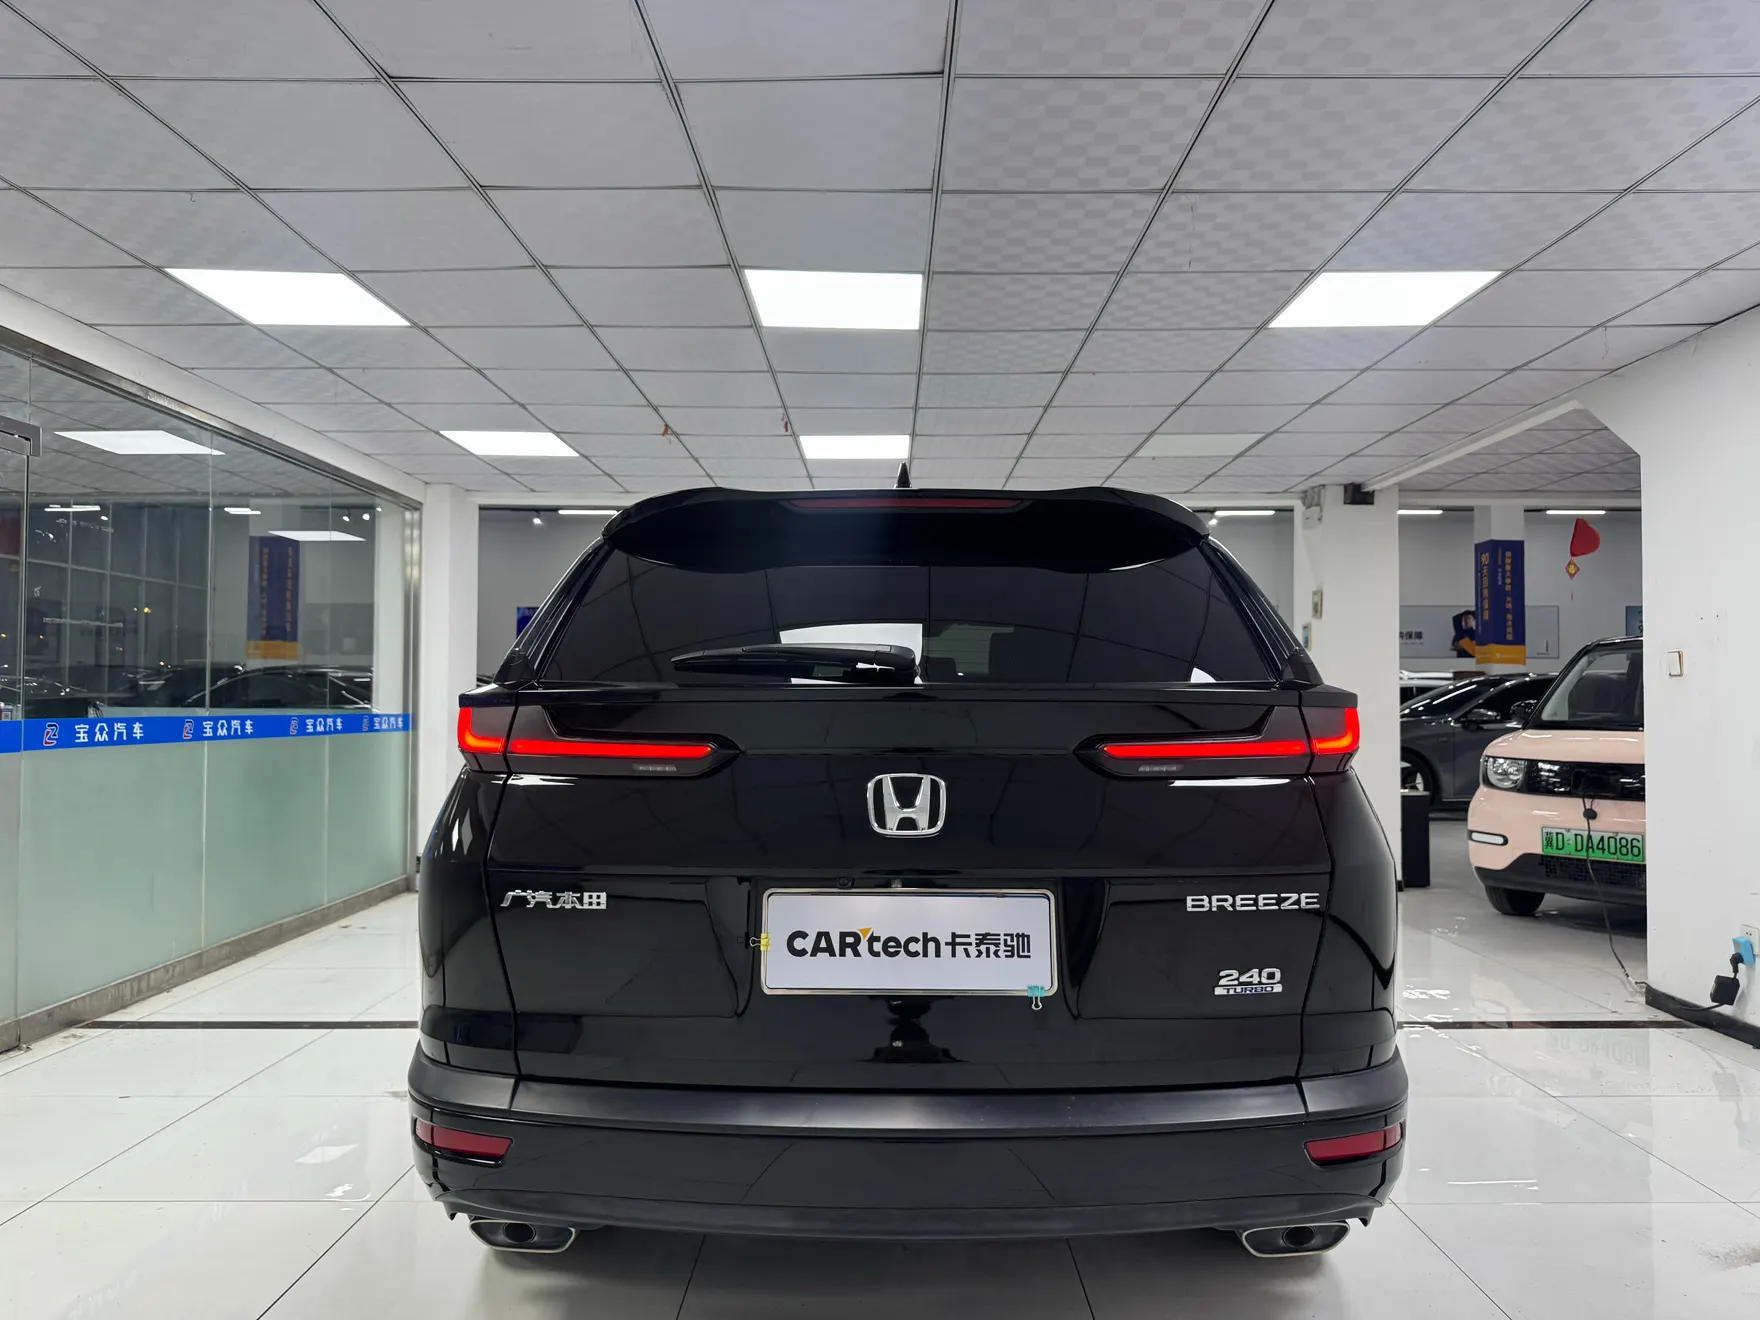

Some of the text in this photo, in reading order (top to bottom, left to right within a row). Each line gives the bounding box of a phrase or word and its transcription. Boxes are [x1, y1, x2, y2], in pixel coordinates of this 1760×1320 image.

[74, 721, 145, 743] 宝众汽车
[202, 719, 254, 737] 宝众汽车
[305, 717, 343, 732] 宝众汽车
[500, 889, 608, 910] 广汽本田
[1186, 892, 1321, 912] BREEZE
[1218, 967, 1282, 986] 240
[1222, 985, 1275, 995] TURBO
